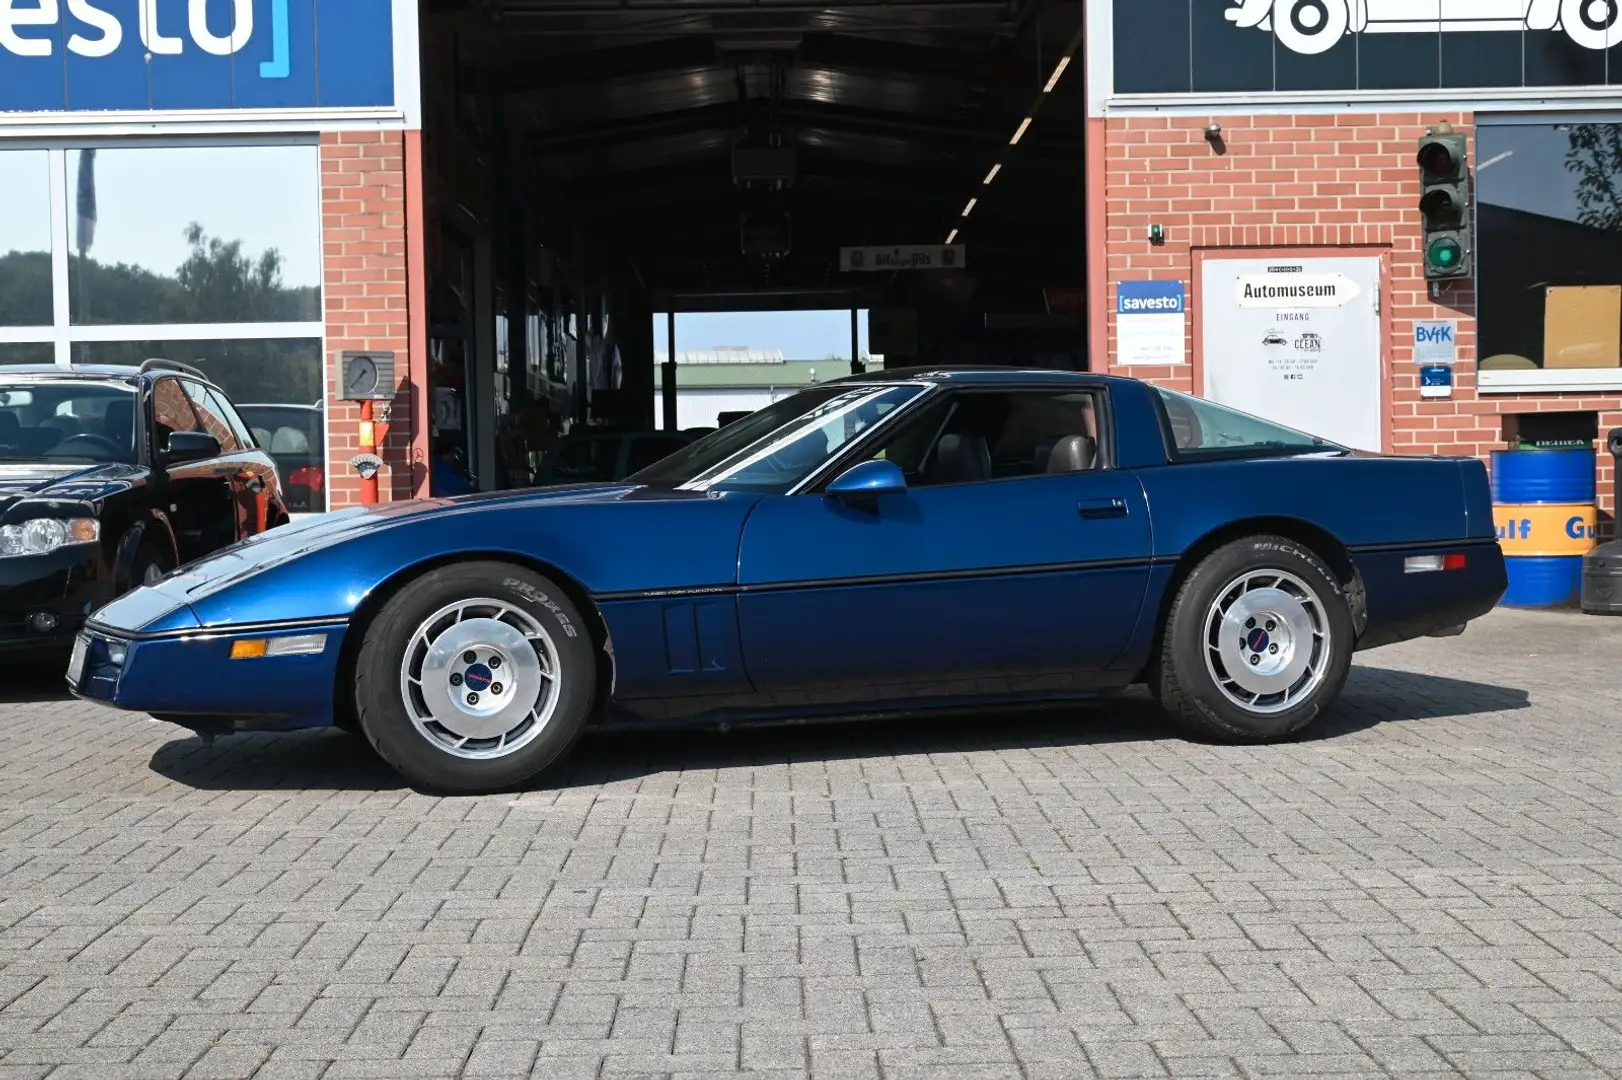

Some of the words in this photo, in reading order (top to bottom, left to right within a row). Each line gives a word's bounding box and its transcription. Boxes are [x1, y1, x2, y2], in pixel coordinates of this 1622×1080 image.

[1244, 283, 1336, 298] Automuseum
[1276, 313, 1310, 321] EINGANG
[1294, 339, 1321, 349] CLEAN
[1254, 543, 1341, 595] MICHELIN
